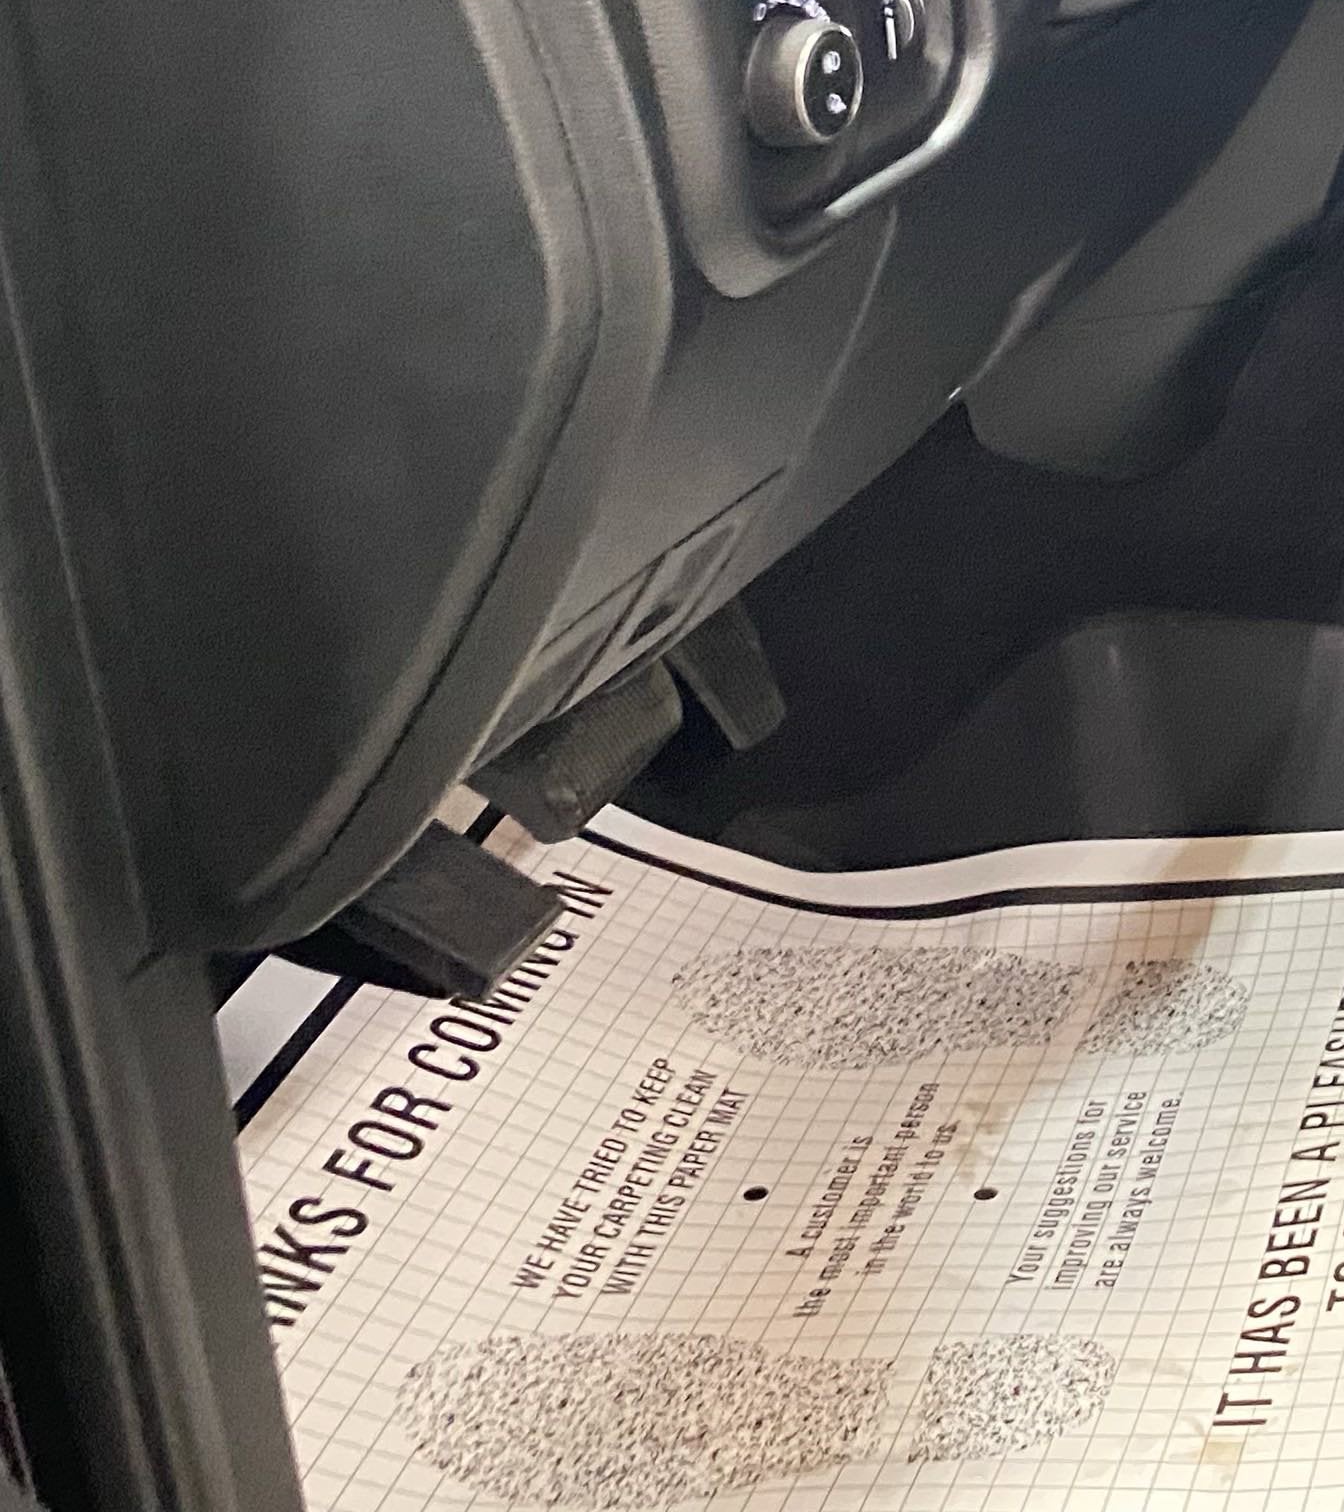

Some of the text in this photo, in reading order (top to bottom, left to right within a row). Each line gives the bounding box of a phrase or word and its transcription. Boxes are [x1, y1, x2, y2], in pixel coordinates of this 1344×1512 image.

[322, 1085, 453, 1192] FOR
[510, 1057, 676, 1289] WE HAVE TRIED TO KEEP
[552, 1069, 717, 1299] YOUR CARPETING CLEAN
[601, 1087, 749, 1295] WITH THIS PAPER MAT
[916, 1150, 944, 1167] to
[1045, 1091, 1147, 1290] improving our service
[1095, 1091, 1184, 1288] are always welcome.
[1291, 1141, 1340, 1162] A
[786, 1136, 873, 1259] A customer is
[793, 1082, 940, 1317] the most important person
[869, 1224, 904, 1252] the
[892, 1172, 933, 1219] world
[1005, 1100, 1107, 1285] Your suggestions for
[1258, 1178, 1331, 1280] BEEN
[855, 1258, 888, 1275] in
[1229, 1295, 1301, 1374] HAS
[1212, 1392, 1272, 1426] IT
